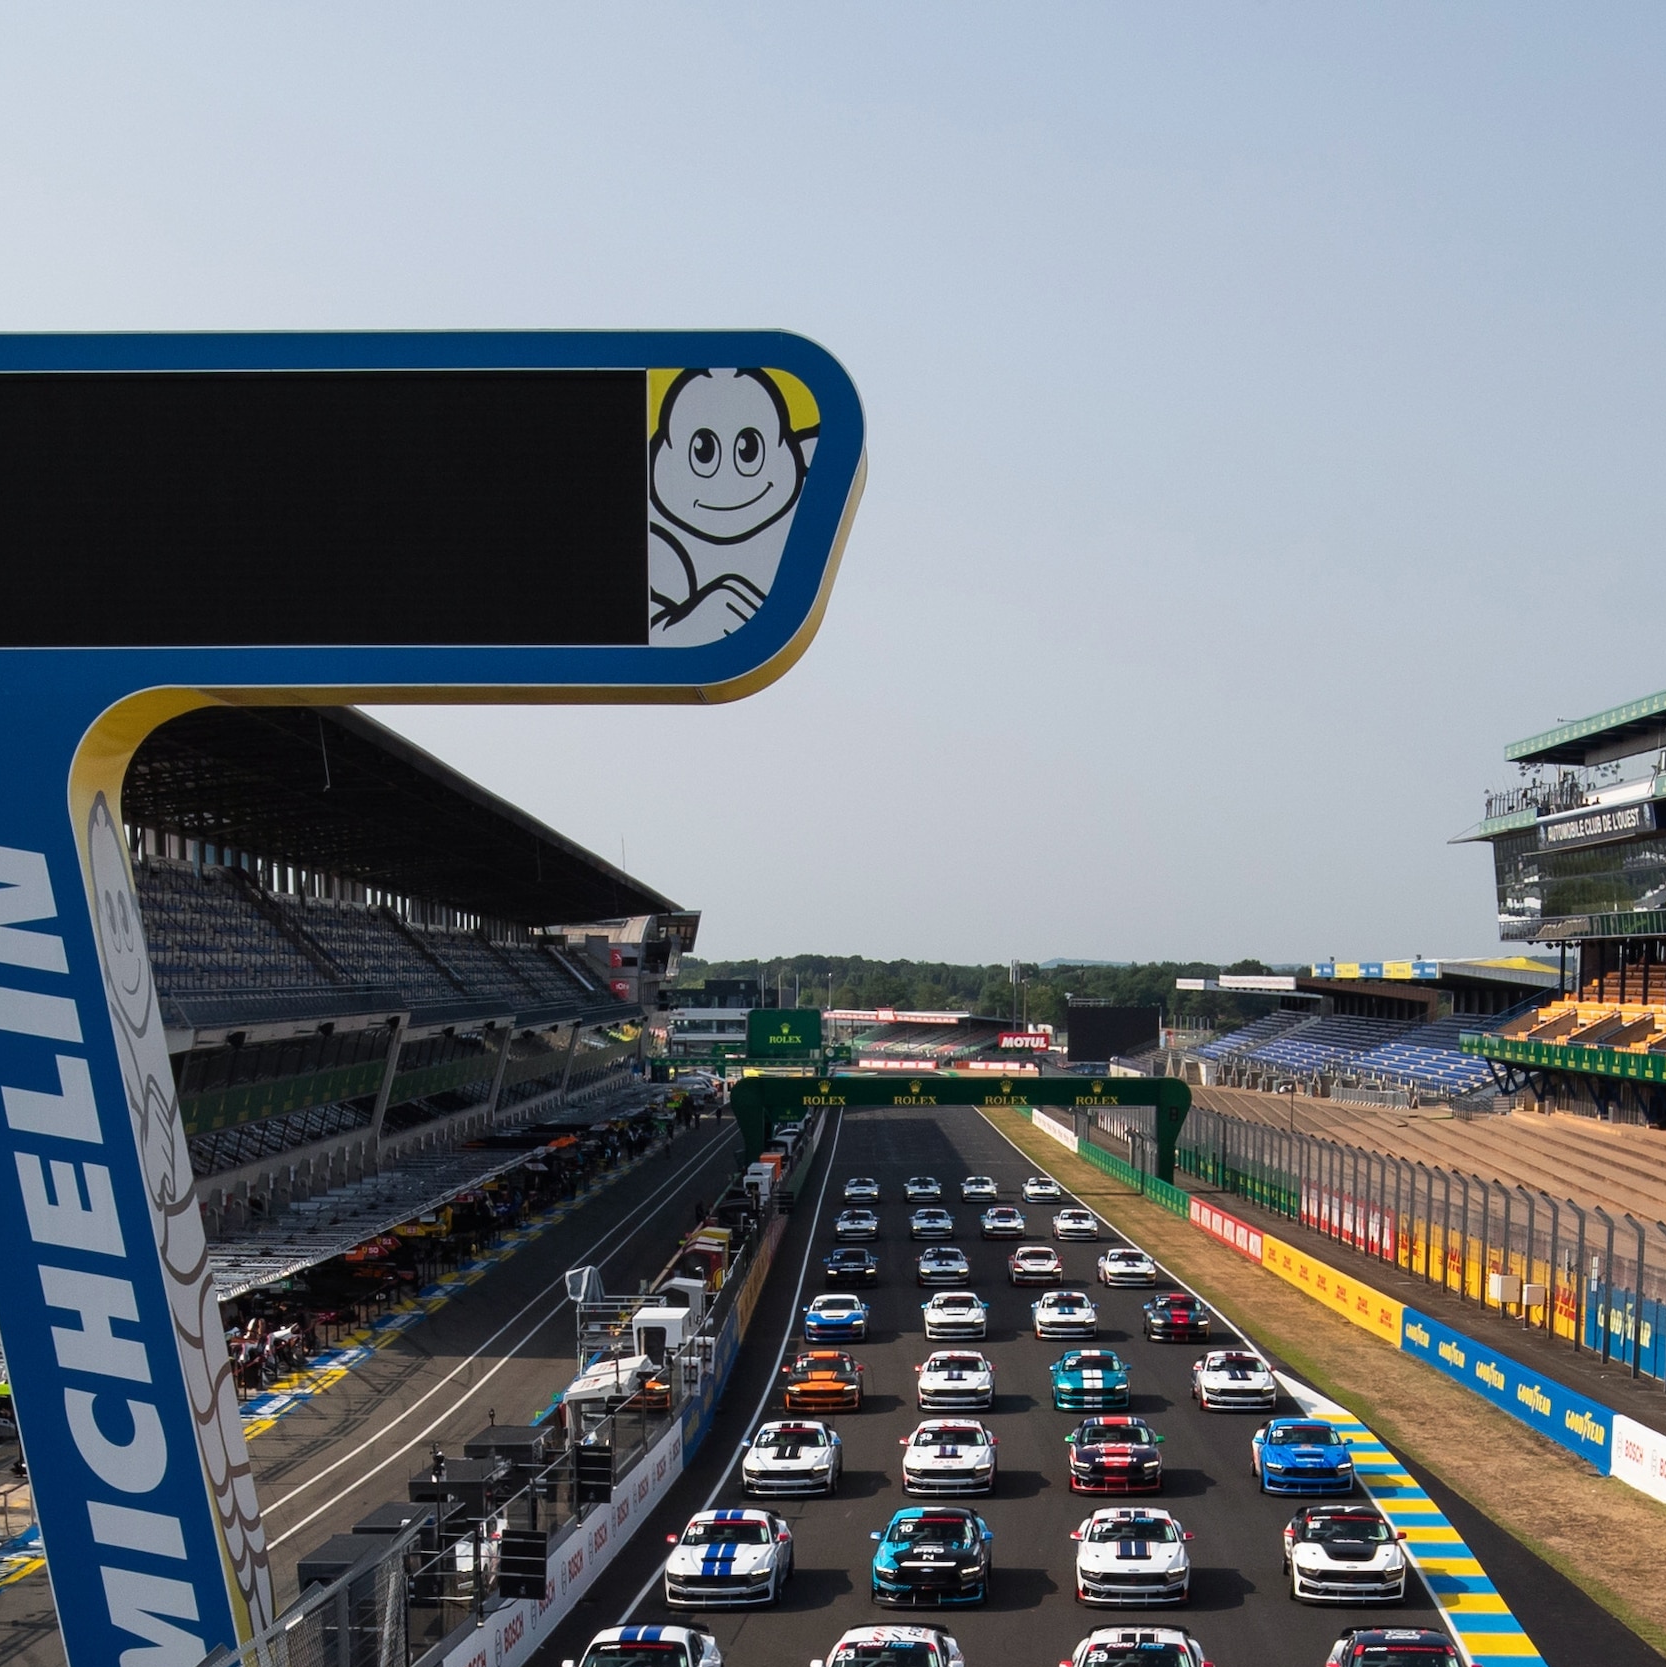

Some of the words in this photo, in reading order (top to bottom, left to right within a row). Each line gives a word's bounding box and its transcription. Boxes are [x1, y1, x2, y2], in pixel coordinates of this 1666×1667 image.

[1547, 822, 1584, 843] AUTOMOBILE
[1585, 818, 1602, 836] CLUB
[1603, 816, 1612, 832] DE
[1612, 808, 1640, 831] L'OUEST
[769, 1036, 802, 1044] ROLEX
[1001, 1036, 1048, 1050] MOTUL
[803, 1096, 846, 1106] ROLEX
[893, 1096, 937, 1106] ROLEX
[985, 1096, 1028, 1106] ROLEX
[1075, 1096, 1119, 1106] ROLEX
[1438, 1339, 1466, 1370] GOODYEAR
[1475, 1358, 1506, 1392] GOODYEAR
[1517, 1380, 1552, 1419] GOODYEAR
[1565, 1408, 1606, 1447] GOODYEAR
[1624, 1438, 1644, 1466] BOSCH
[617, 1506, 630, 1529] BOSCH
[593, 1532, 609, 1557] BOSCH
[567, 1557, 584, 1586] BOSCH
[503, 1611, 525, 1653] BOSCH
[836, 1650, 855, 1662] 23
[1088, 1652, 1109, 1663] 29
